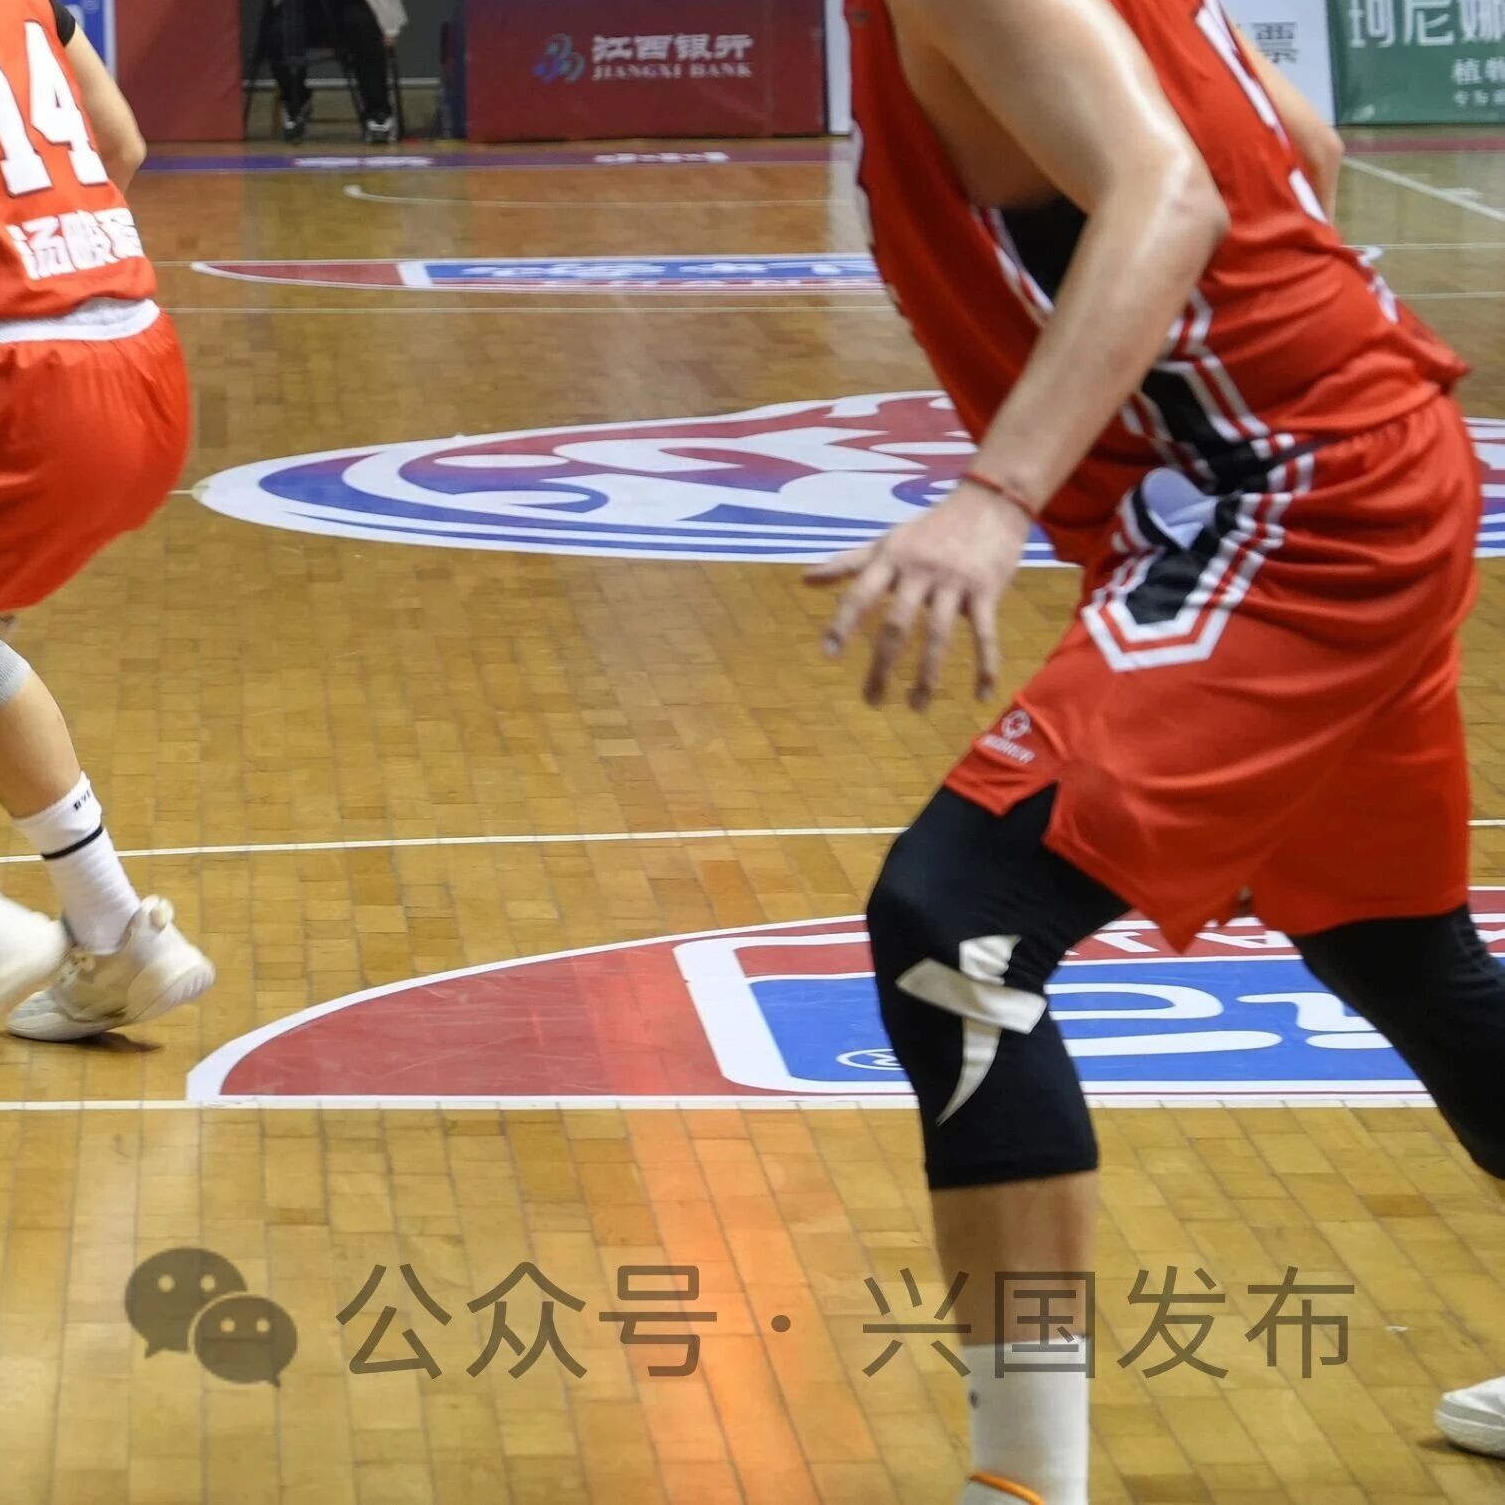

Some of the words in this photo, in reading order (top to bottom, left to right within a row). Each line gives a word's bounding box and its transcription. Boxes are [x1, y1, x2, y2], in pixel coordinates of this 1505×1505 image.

[592, 33, 754, 64] 江西银行
[690, 60, 753, 79] BANK
